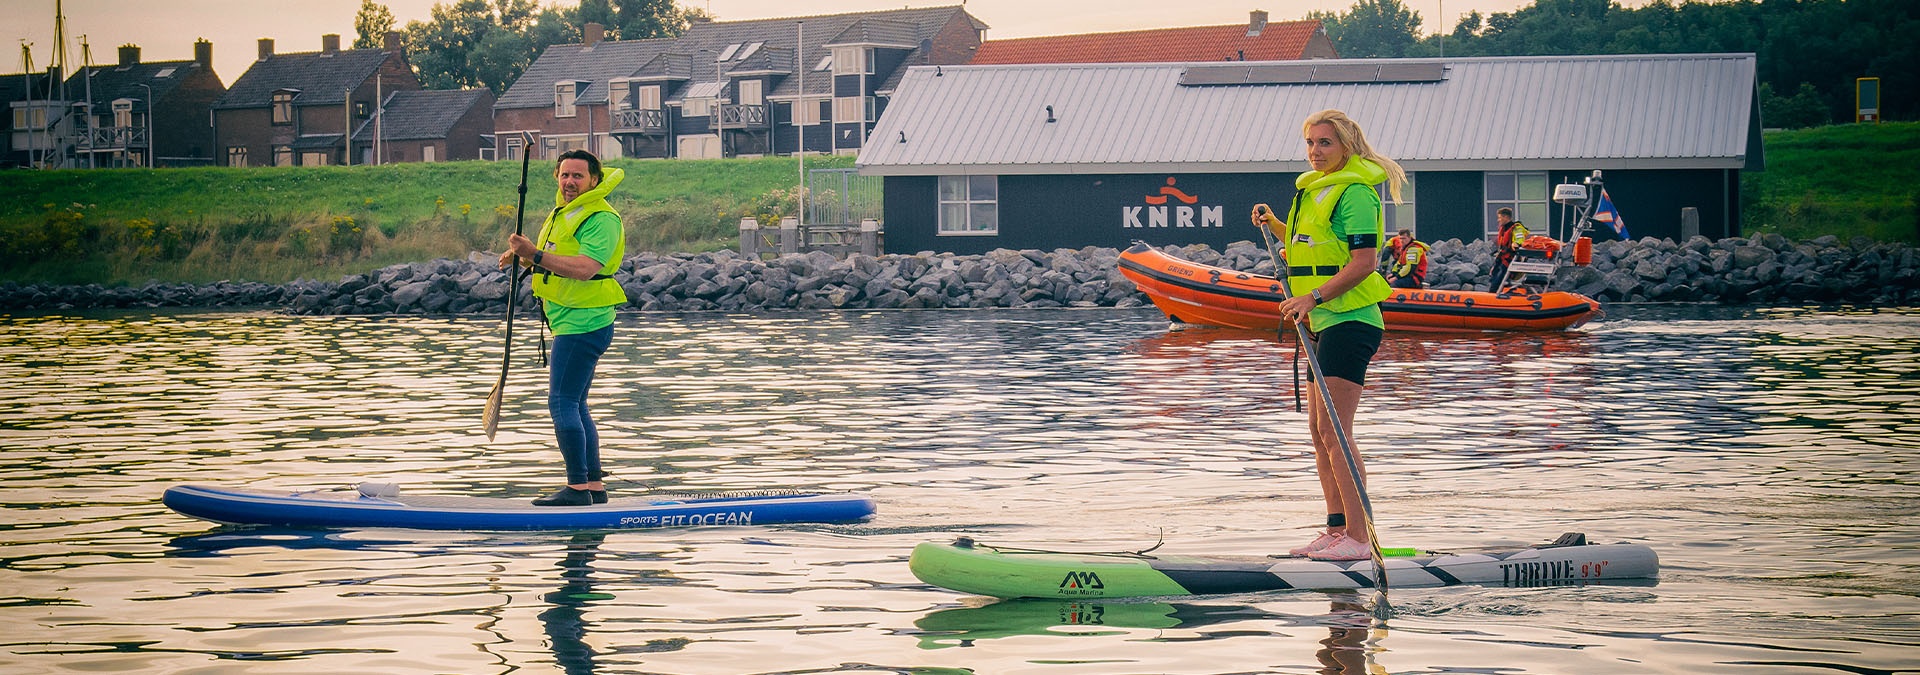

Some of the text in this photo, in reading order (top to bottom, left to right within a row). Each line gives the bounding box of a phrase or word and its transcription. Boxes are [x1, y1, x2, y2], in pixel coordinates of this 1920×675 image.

[1123, 206, 1223, 228] KNRM
[1167, 265, 1194, 276] GRIEND
[1410, 292, 1461, 303] KNRM
[620, 511, 753, 525] SPORTS FIT OCEAN
[1500, 560, 1575, 581] THRIVE
